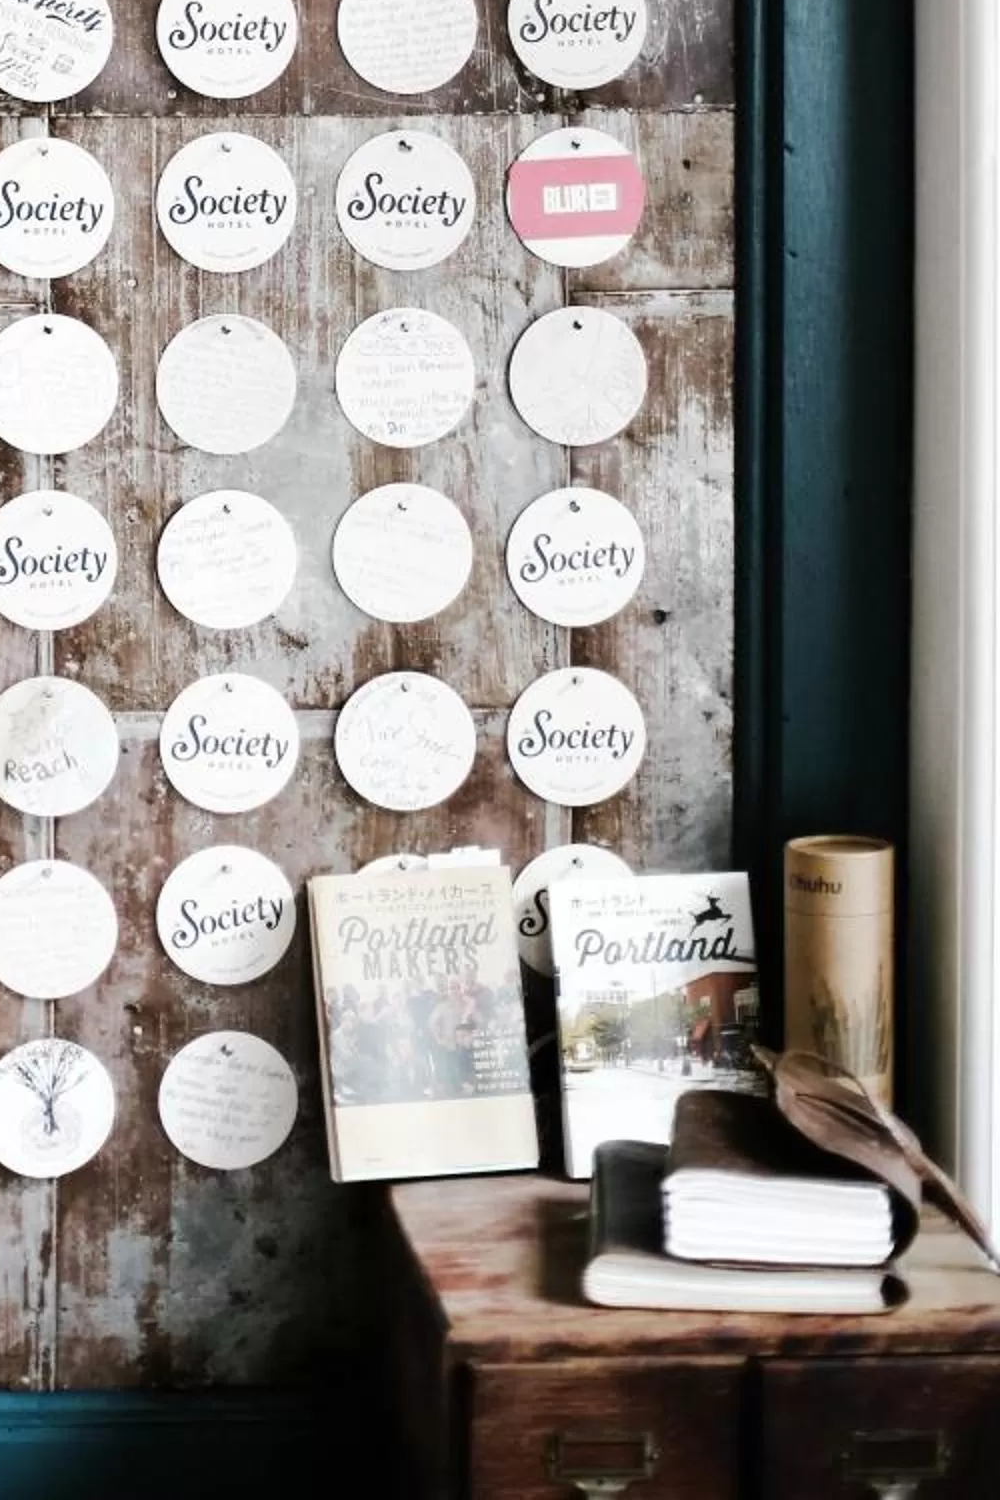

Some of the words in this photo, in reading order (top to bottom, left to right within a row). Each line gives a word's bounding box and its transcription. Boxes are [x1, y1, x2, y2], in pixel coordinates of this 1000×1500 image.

[168, 1, 287, 52] Society
[168, 176, 287, 225] Society
[347, 172, 466, 227] Society
[520, 534, 637, 583] Society
[171, 715, 288, 765] Society
[518, 710, 635, 757] Society
[3, 748, 79, 784] Reach
[171, 897, 284, 949] Society
[338, 912, 498, 953] Portland
[575, 927, 740, 967] Portland
[362, 947, 479, 981] MAKERS
